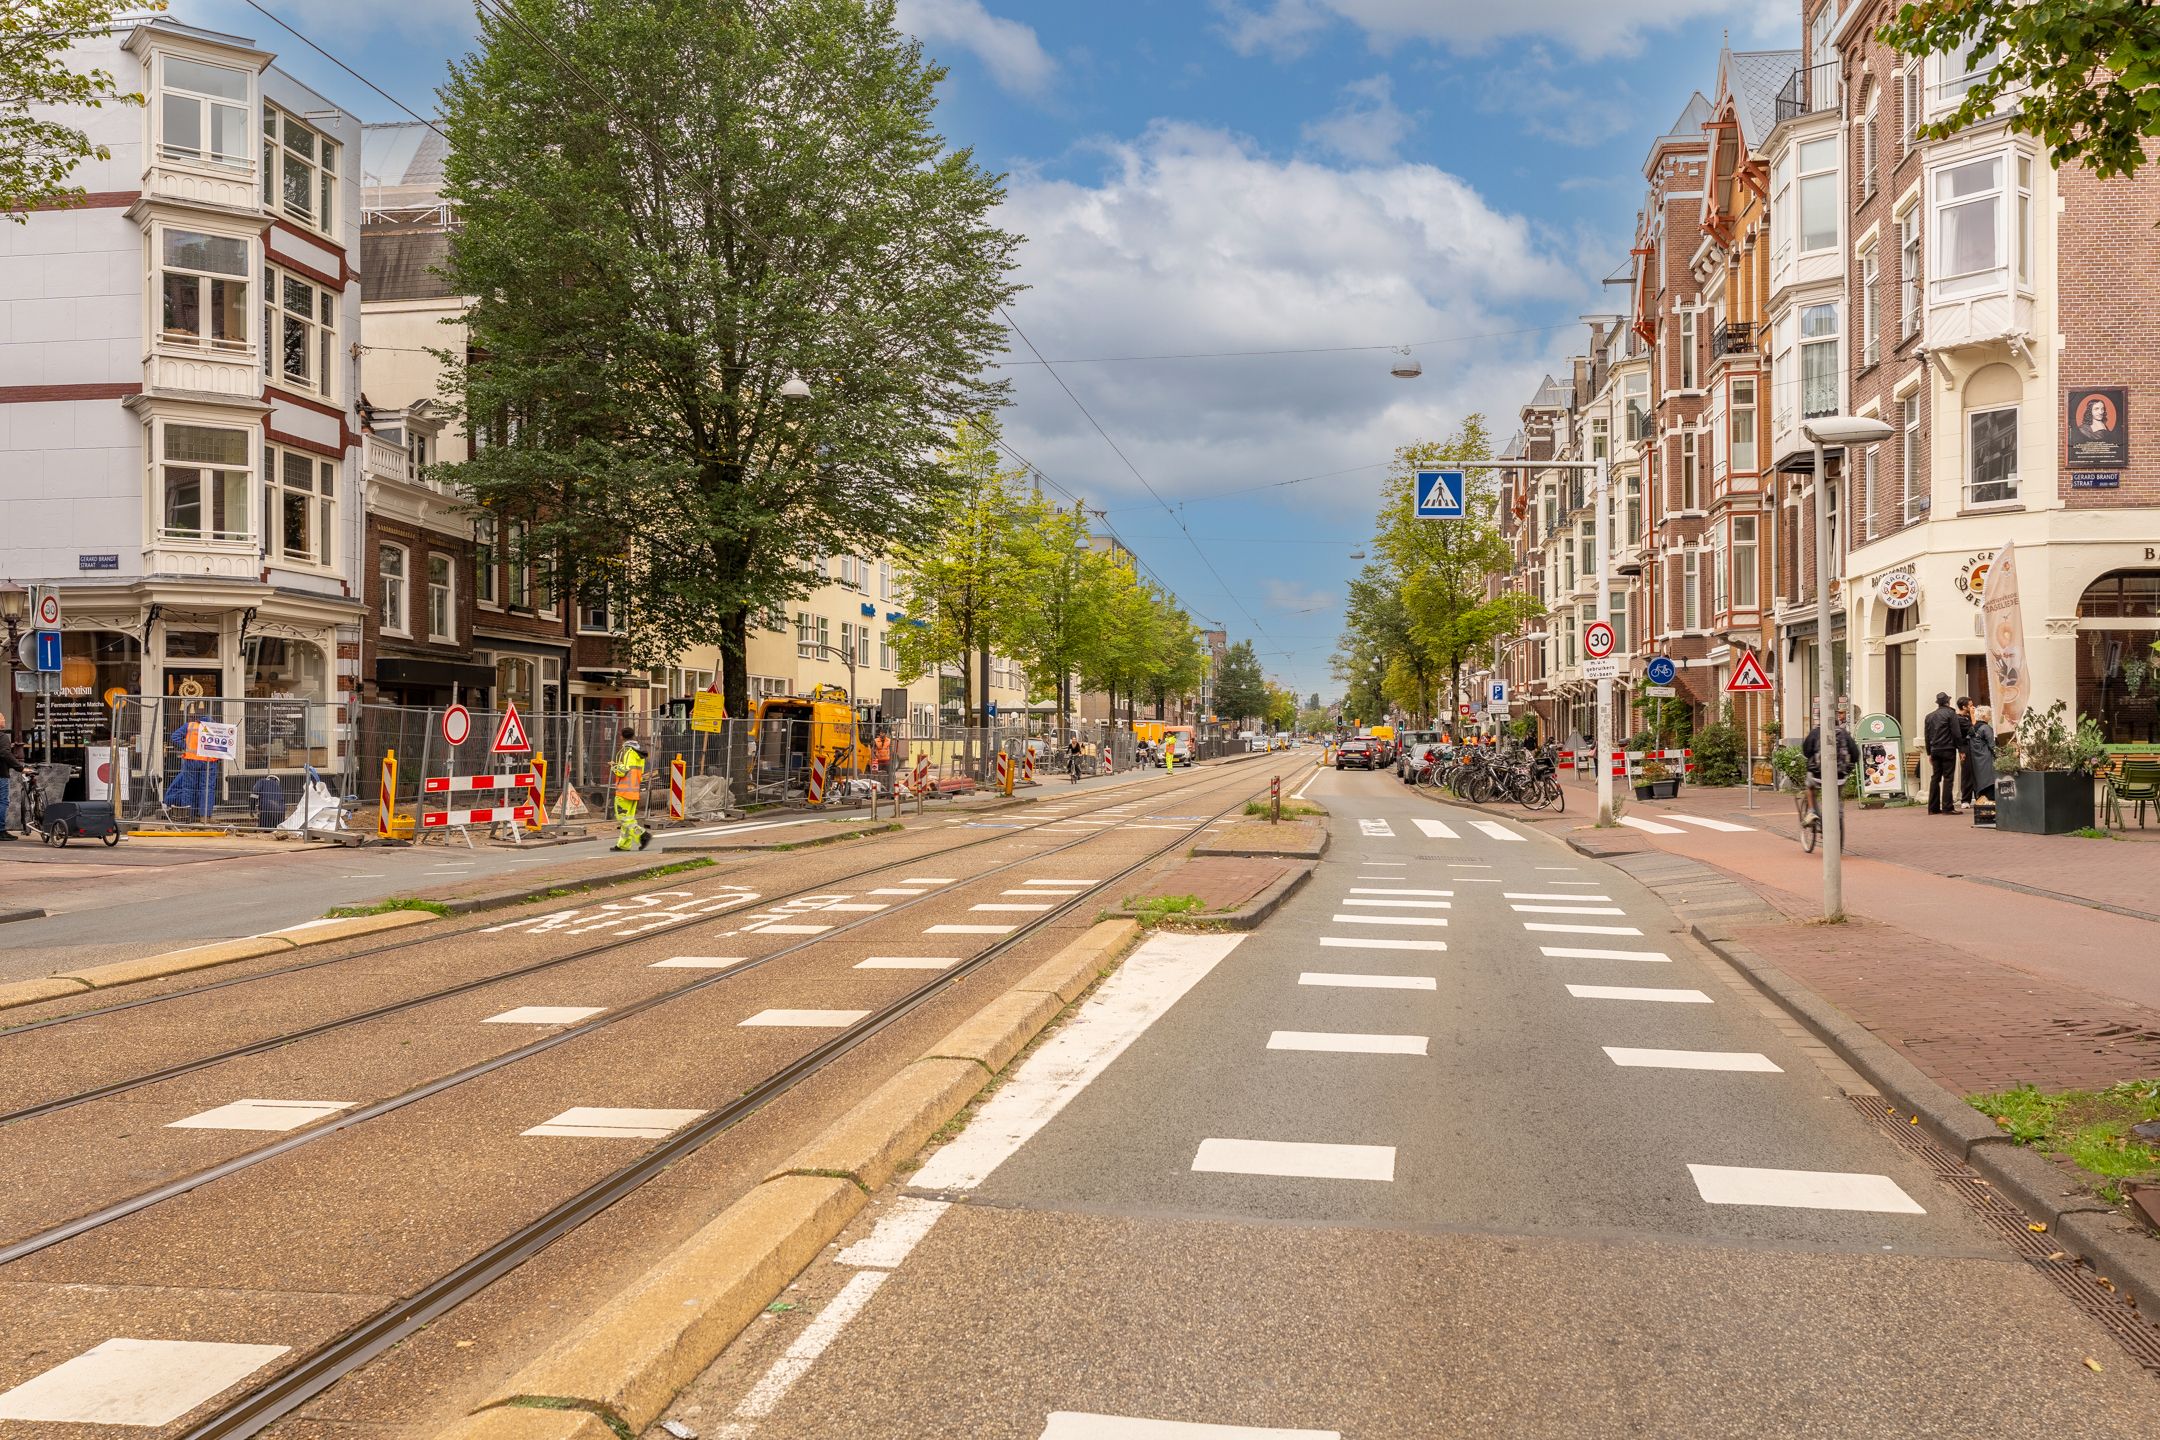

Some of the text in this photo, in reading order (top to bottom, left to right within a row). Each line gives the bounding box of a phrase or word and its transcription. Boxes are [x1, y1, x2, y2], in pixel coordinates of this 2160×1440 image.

[1961, 551, 1995, 573] BAGE
[1885, 574, 1915, 587] BAGELS
[1886, 596, 1914, 606] BEANS
[45, 604, 55, 615] 30
[1591, 633, 1609, 647] 30
[601, 892, 854, 913] BUS
